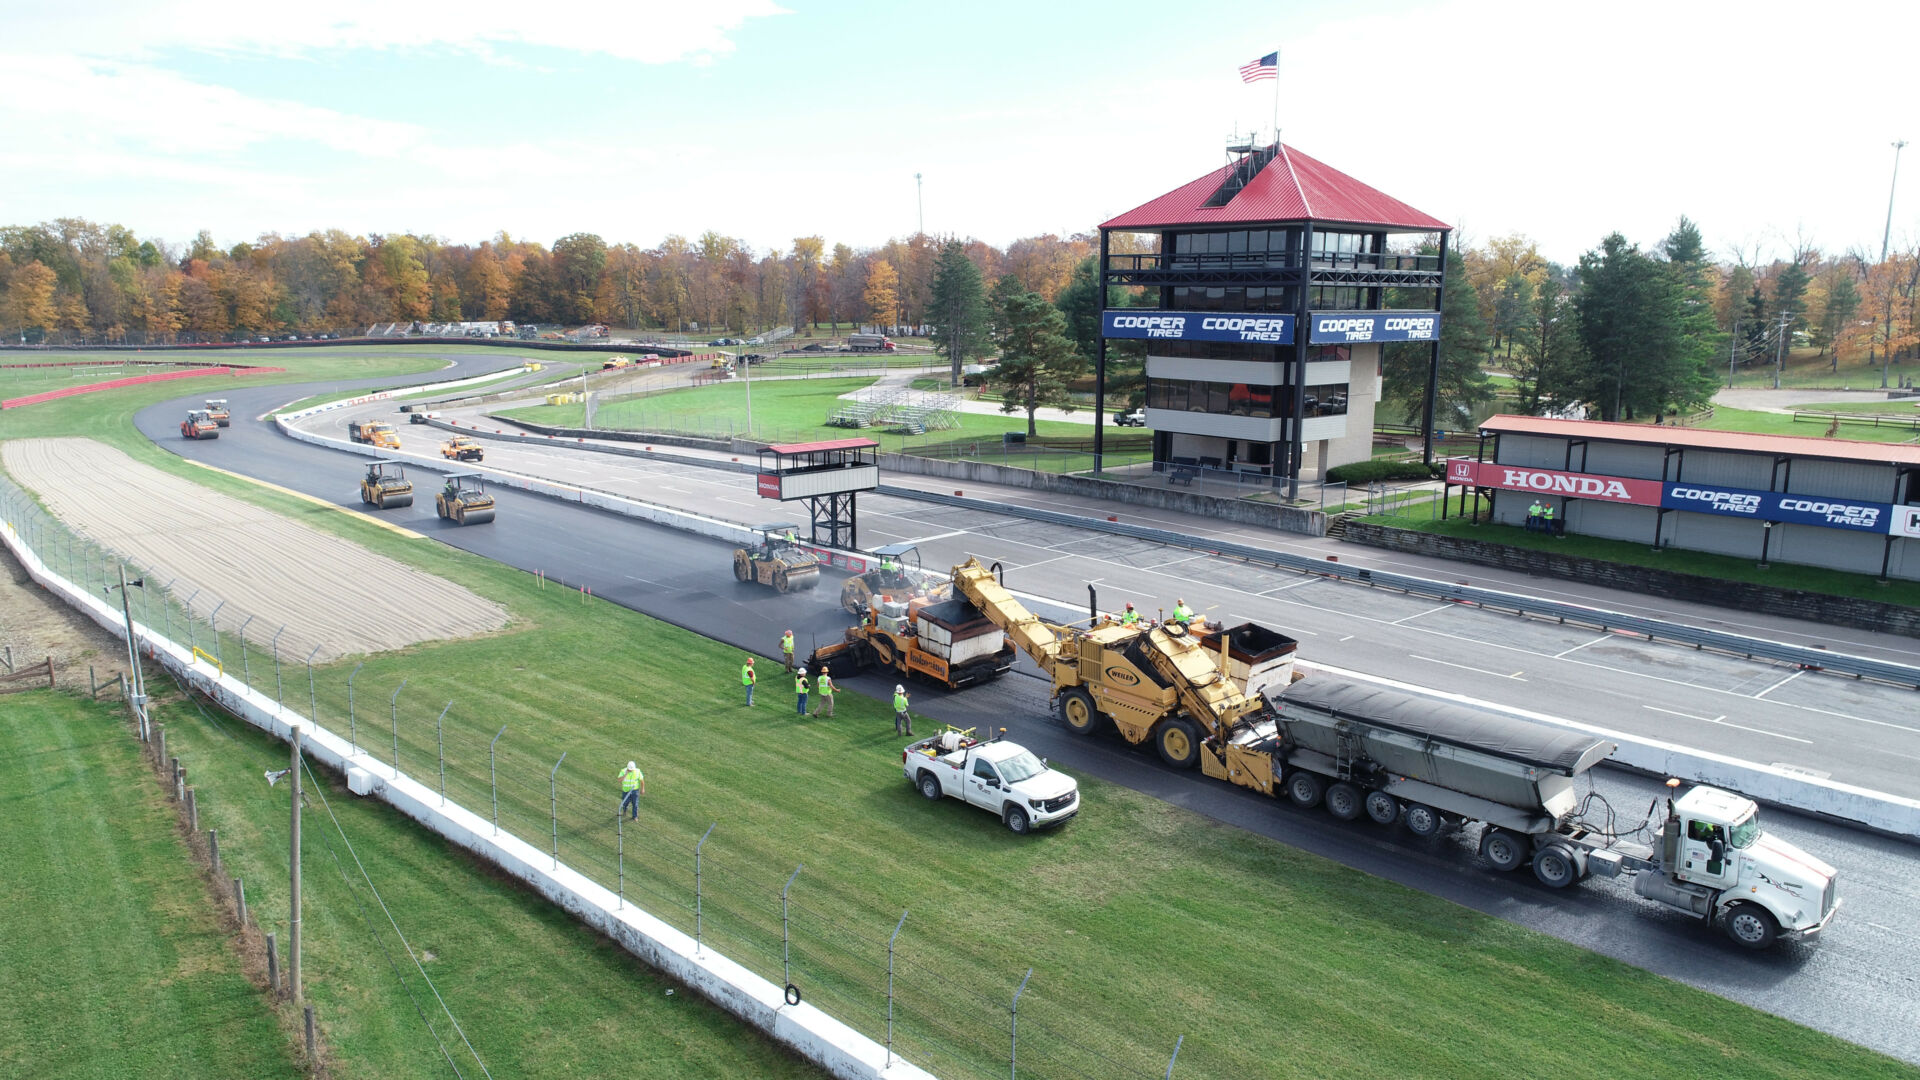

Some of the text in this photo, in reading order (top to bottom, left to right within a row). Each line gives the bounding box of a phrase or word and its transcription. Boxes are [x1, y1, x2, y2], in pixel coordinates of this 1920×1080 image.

[1113, 316, 1186, 329] COOPER
[1202, 317, 1284, 332] COOPER
[1319, 318, 1375, 333] COOPER
[1384, 318, 1434, 331] COOPER
[1147, 328, 1183, 338] TIRES
[1239, 331, 1281, 341] TIRES
[1345, 331, 1372, 340] TIRES
[1407, 330, 1432, 338] TIRES
[1449, 475, 1474, 483] HONDA
[1502, 469, 1632, 499] HONDA
[1670, 487, 1762, 506] COOPER
[1712, 501, 1759, 514] TIRES
[1778, 498, 1881, 520] COOPER
[1826, 514, 1876, 527] TIRES
[1111, 670, 1134, 682] WEILER
